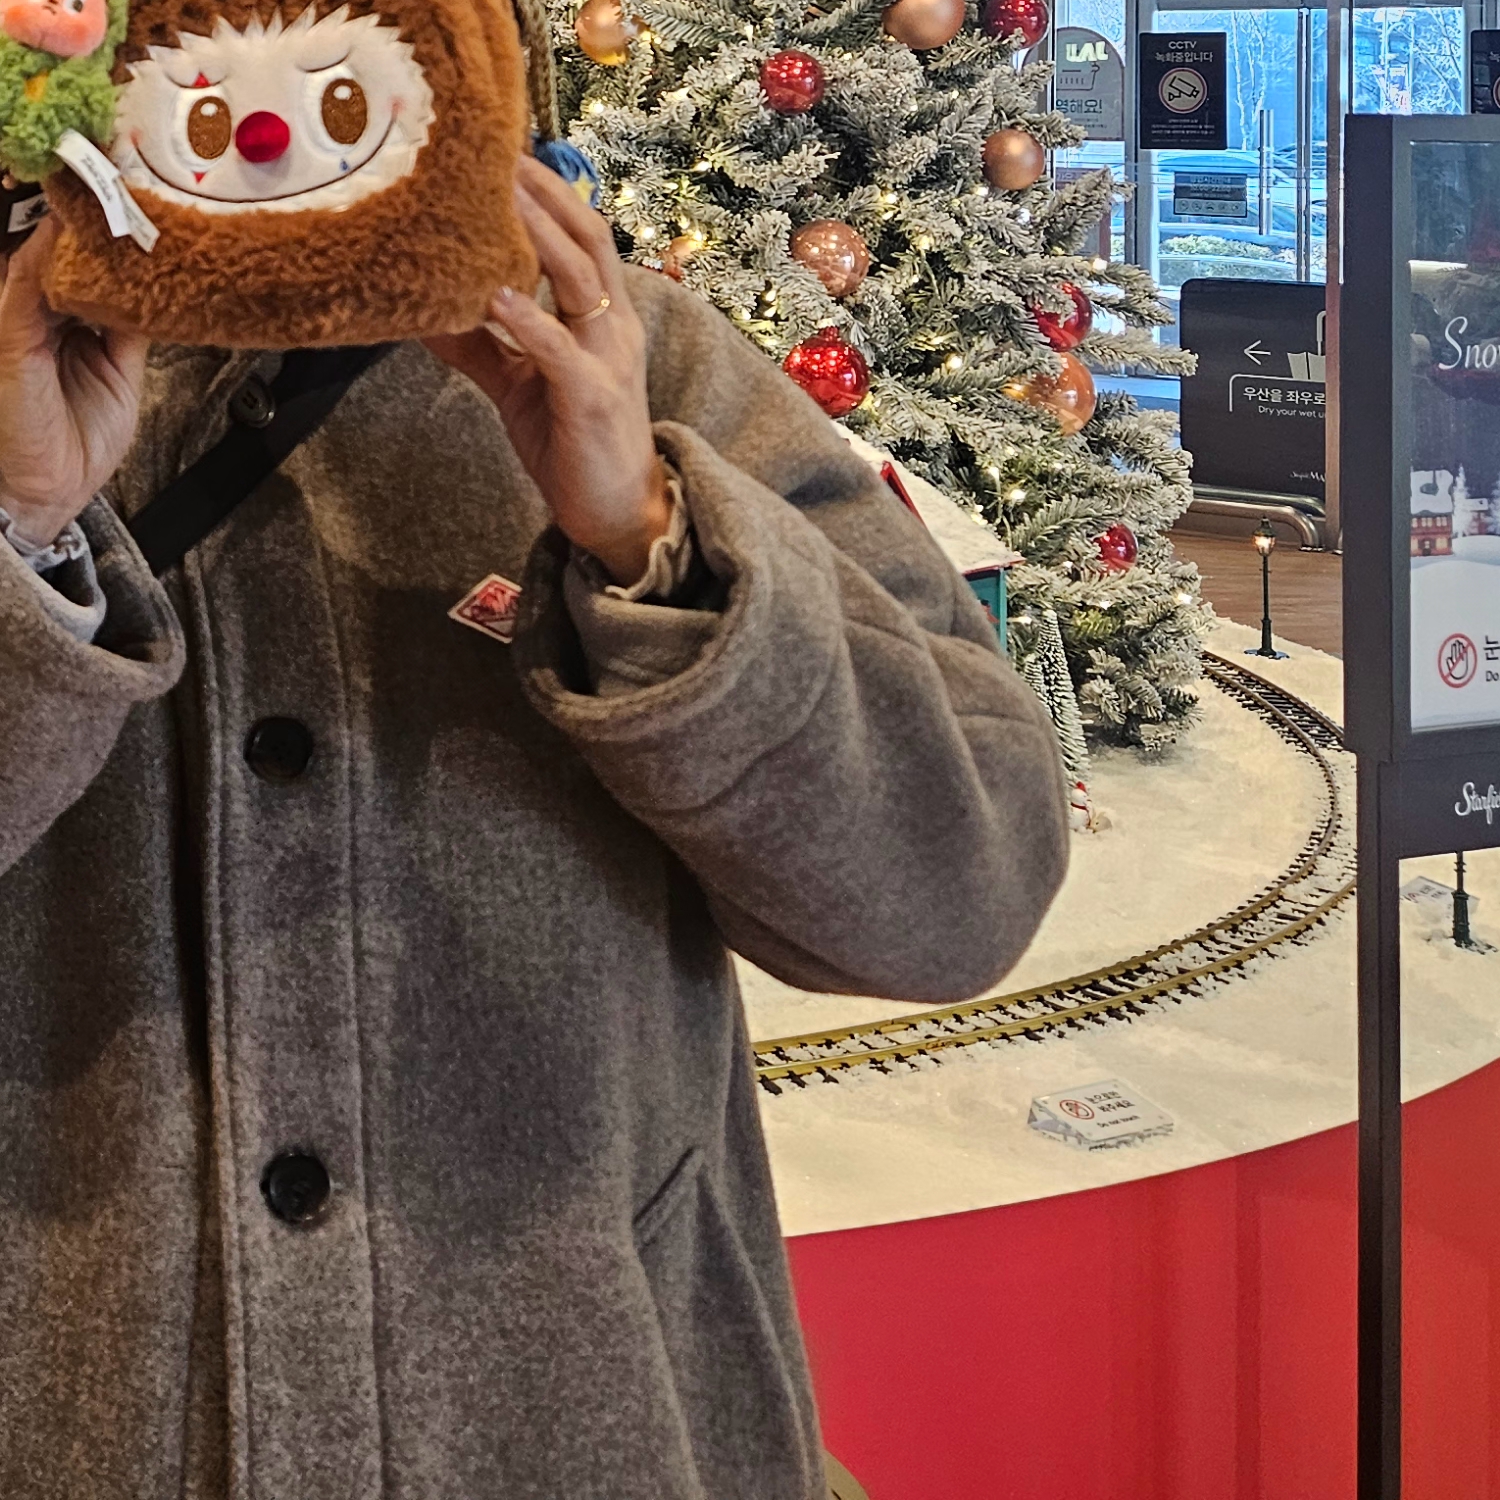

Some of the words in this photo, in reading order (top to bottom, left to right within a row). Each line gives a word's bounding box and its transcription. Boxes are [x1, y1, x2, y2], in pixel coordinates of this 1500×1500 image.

[1168, 41, 1197, 50] CCTV
[1155, 52, 1213, 63] 녹화중입니다
[1056, 99, 1102, 114] 영해요!
[1438, 316, 1500, 370] Sno
[1243, 387, 1282, 403] 우산을
[1286, 390, 1326, 405] 좌우로
[1258, 405, 1274, 416] Dry
[1276, 408, 1297, 417] your
[1299, 410, 1317, 418] wet
[1485, 670, 1500, 682] Do
